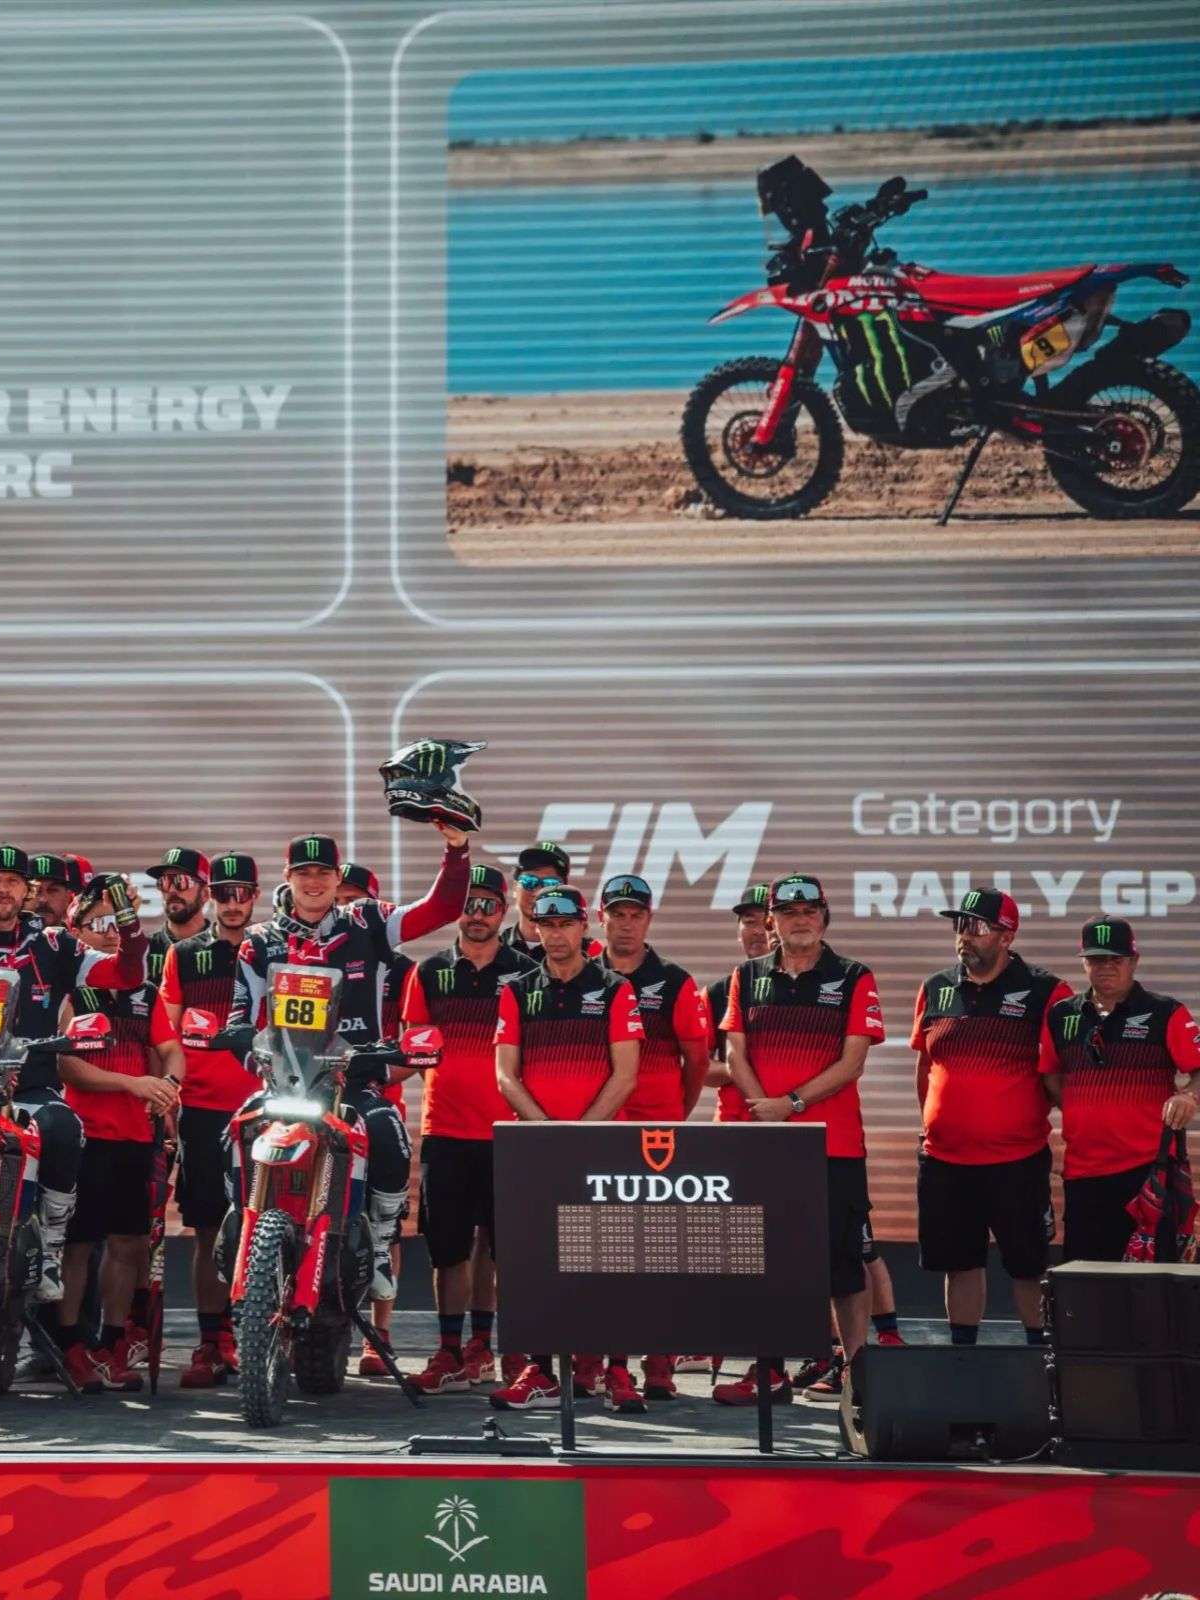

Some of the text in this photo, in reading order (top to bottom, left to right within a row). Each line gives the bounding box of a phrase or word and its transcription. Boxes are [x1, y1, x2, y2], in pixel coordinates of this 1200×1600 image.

[27, 383, 293, 433] ENERGY
[852, 791, 1121, 843] Category
[505, 802, 774, 910] FIM
[853, 870, 1198, 918] RALLY GP
[285, 998, 315, 1026] 68
[75, 1041, 104, 1050] MOTUL
[410, 1057, 437, 1066] MOTUL
[586, 1174, 733, 1203] TUDOR
[312, 1231, 327, 1293] HONDA
[368, 1572, 548, 1594] SAUDI ARABIA
